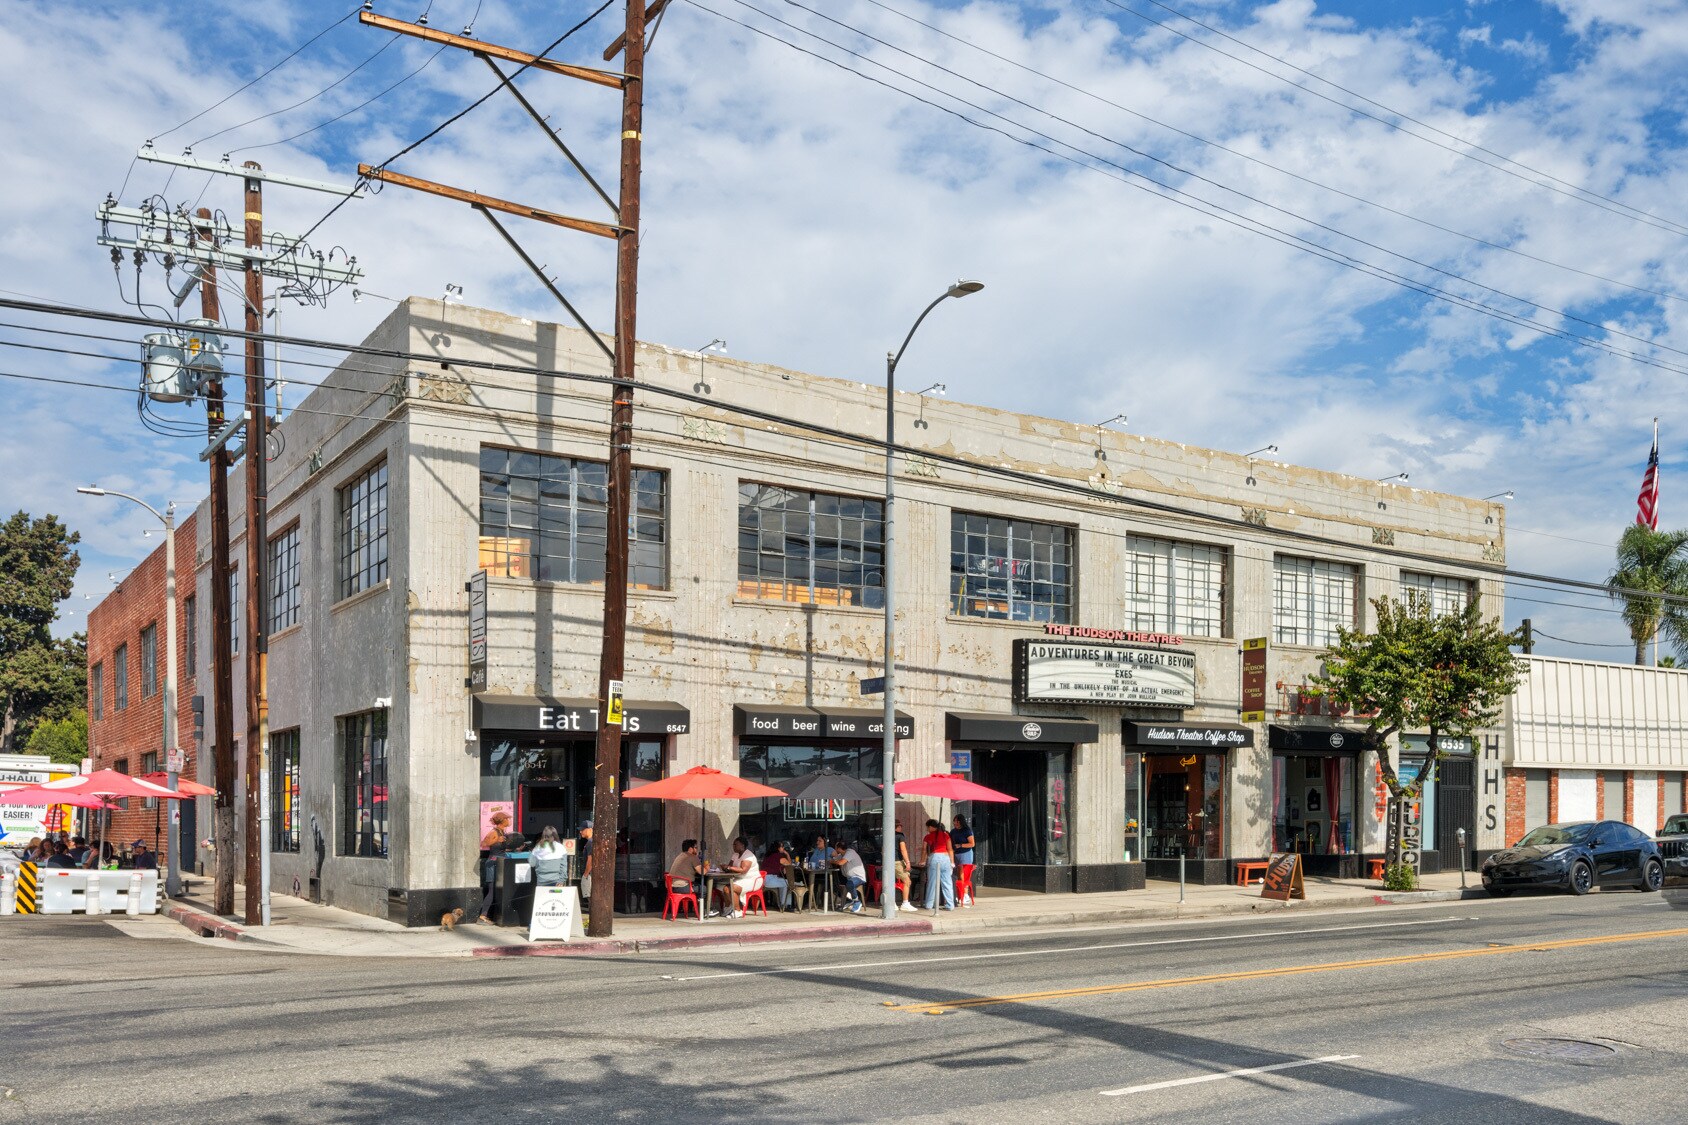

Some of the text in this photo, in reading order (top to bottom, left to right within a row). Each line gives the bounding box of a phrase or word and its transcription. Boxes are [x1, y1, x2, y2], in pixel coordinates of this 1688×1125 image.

[1046, 624, 1184, 646] THE HUDSON THEATRES
[1030, 646, 1194, 669] ADVENTURES IN THE GREAT BEYOND
[472, 668, 484, 685] Café
[1115, 670, 1133, 679] EXES
[1160, 688, 1184, 696] EMERGENCY
[539, 708, 580, 730] Eat
[590, 709, 640, 731] Tis
[752, 717, 909, 735] food beer wine cating
[666, 724, 686, 733] 6547
[1148, 728, 1245, 746] Hudson Theatre Coffee Shop
[1441, 740, 1464, 750] 6535
[524, 760, 547, 769] 6547
[4, 811, 33, 819] EASIER!
